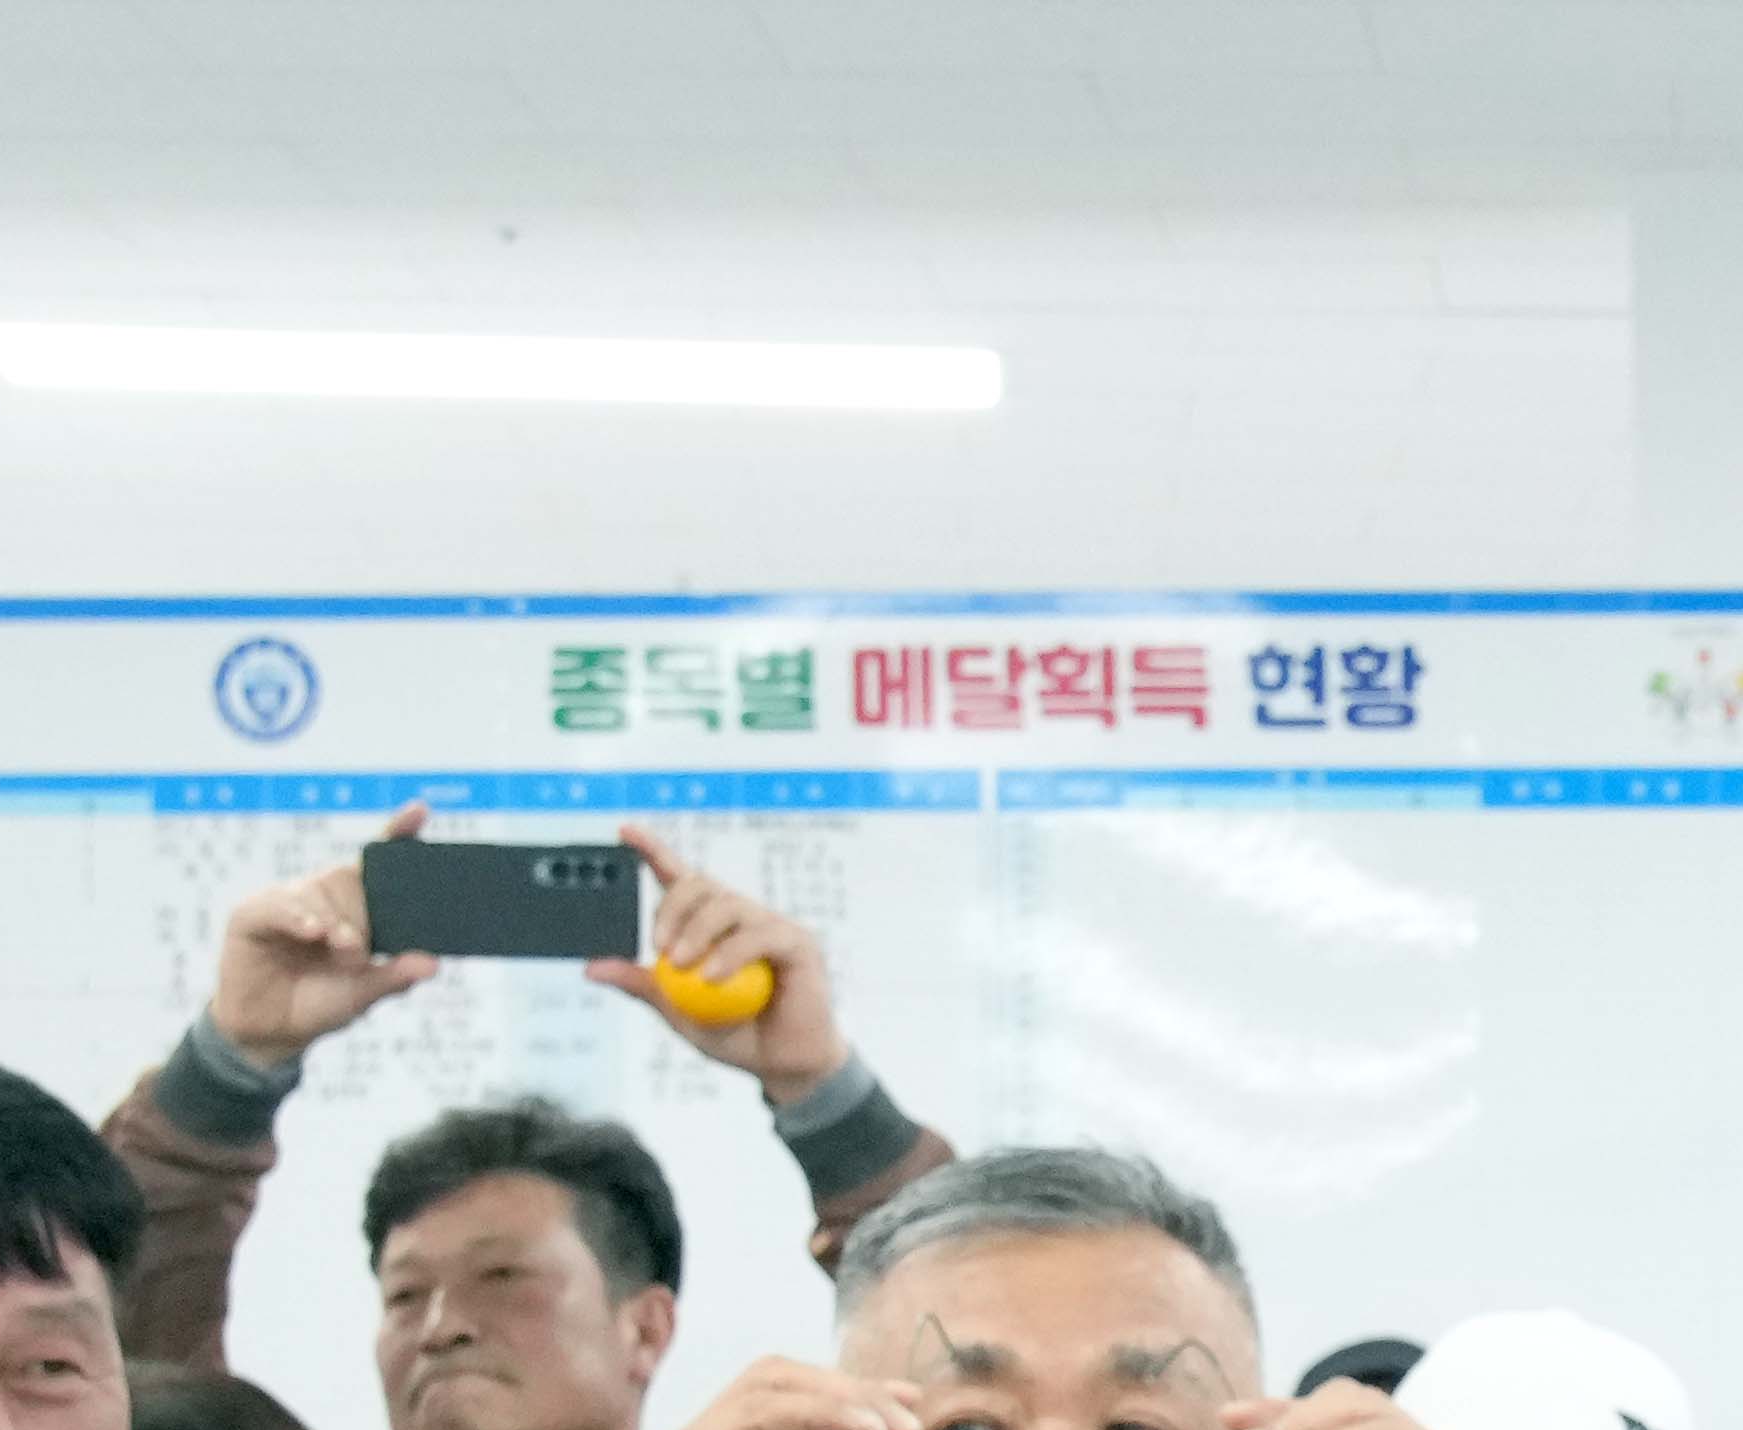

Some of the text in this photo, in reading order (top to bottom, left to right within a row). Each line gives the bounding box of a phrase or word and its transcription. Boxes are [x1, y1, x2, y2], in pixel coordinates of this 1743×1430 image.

[552, 645, 1424, 732] 종목별 메달획득 현황
